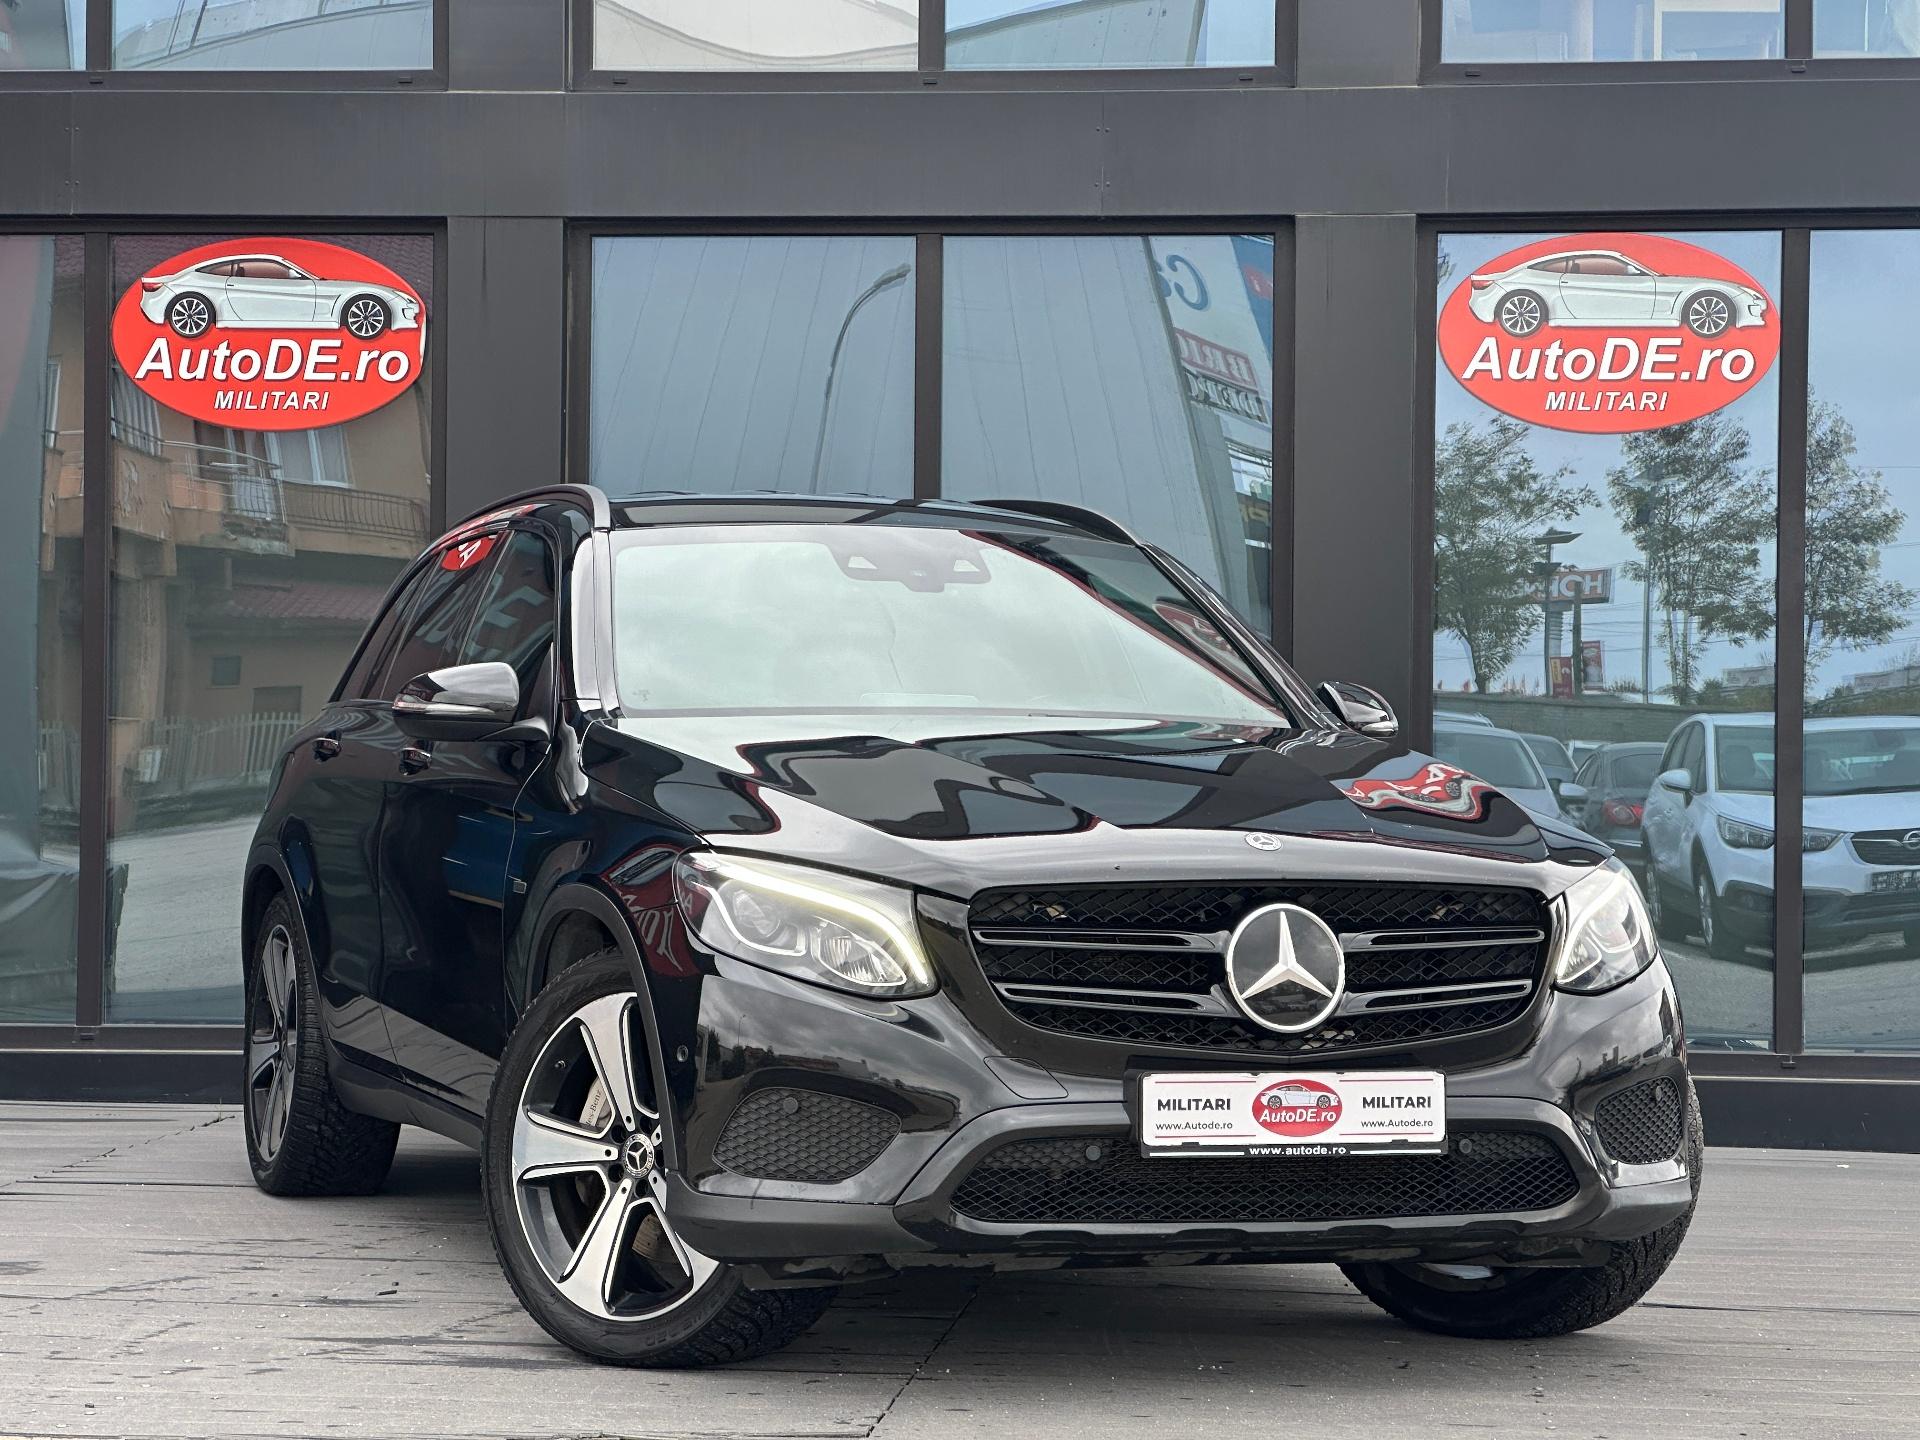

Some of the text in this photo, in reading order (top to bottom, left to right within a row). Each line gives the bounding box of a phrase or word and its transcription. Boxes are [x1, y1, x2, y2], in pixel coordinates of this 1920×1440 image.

[134, 337, 410, 382] AutoDE.ro
[1461, 336, 1756, 382] AutoDE.ro
[213, 390, 329, 410] MILITARI
[1544, 391, 1668, 411] MILITARI
[1157, 1098, 1231, 1111] MILITARI
[1362, 1096, 1432, 1109] MILITARI
[1259, 1108, 1337, 1123] AutoDE.ro
[1155, 1120, 1233, 1130] www.Autode.ro
[1360, 1118, 1434, 1128] www.Autode.ro
[1249, 1145, 1347, 1156] www.autode.ro
